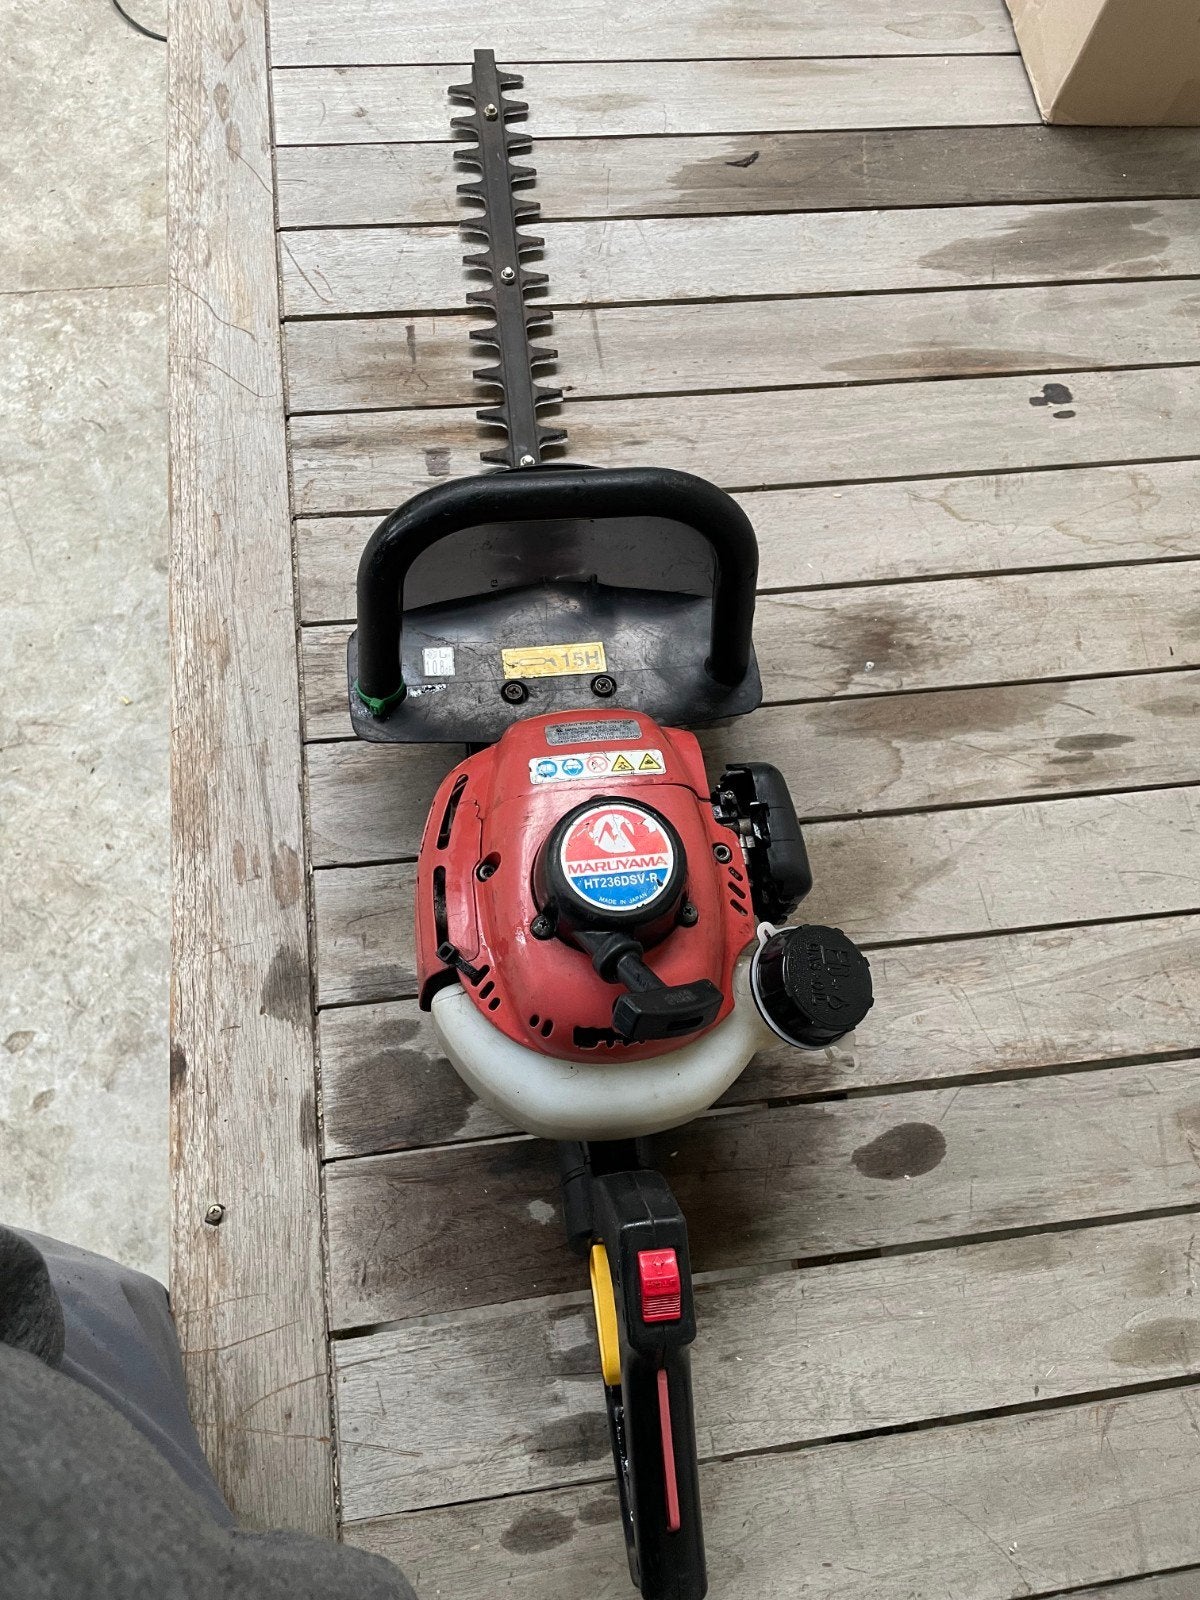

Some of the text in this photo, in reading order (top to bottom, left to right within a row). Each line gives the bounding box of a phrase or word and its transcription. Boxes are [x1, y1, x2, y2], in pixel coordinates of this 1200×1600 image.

[561, 650, 600, 667] 15H
[568, 855, 668, 875] MARUYAMA
[584, 873, 658, 889] HT236DSV-R
[598, 896, 617, 905] MADE
[629, 893, 648, 905] JAPAN
